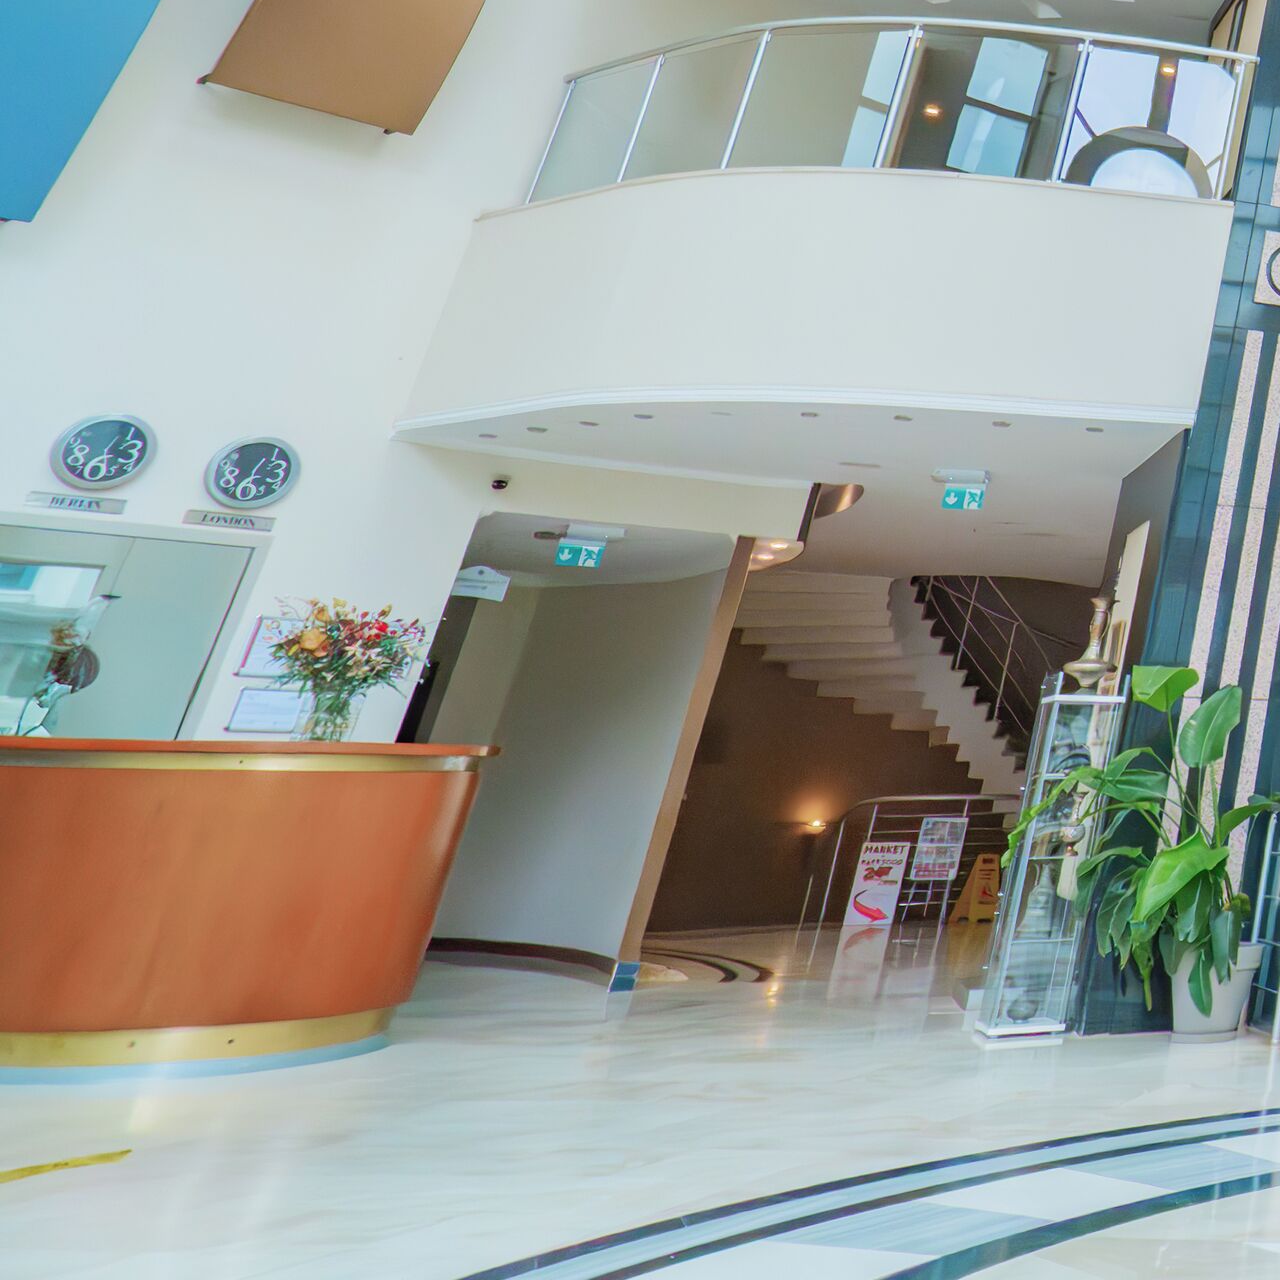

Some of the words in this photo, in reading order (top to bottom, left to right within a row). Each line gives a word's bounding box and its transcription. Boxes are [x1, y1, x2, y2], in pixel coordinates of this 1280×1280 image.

[66, 444, 90, 466] 8
[118, 440, 144, 463] 3
[83, 454, 115, 481] 6
[219, 466, 240, 488] 8
[265, 459, 287, 482] 3
[235, 475, 262, 500] 6
[200, 512, 256, 528] LONDON
[863, 845, 907, 855] MARKET
